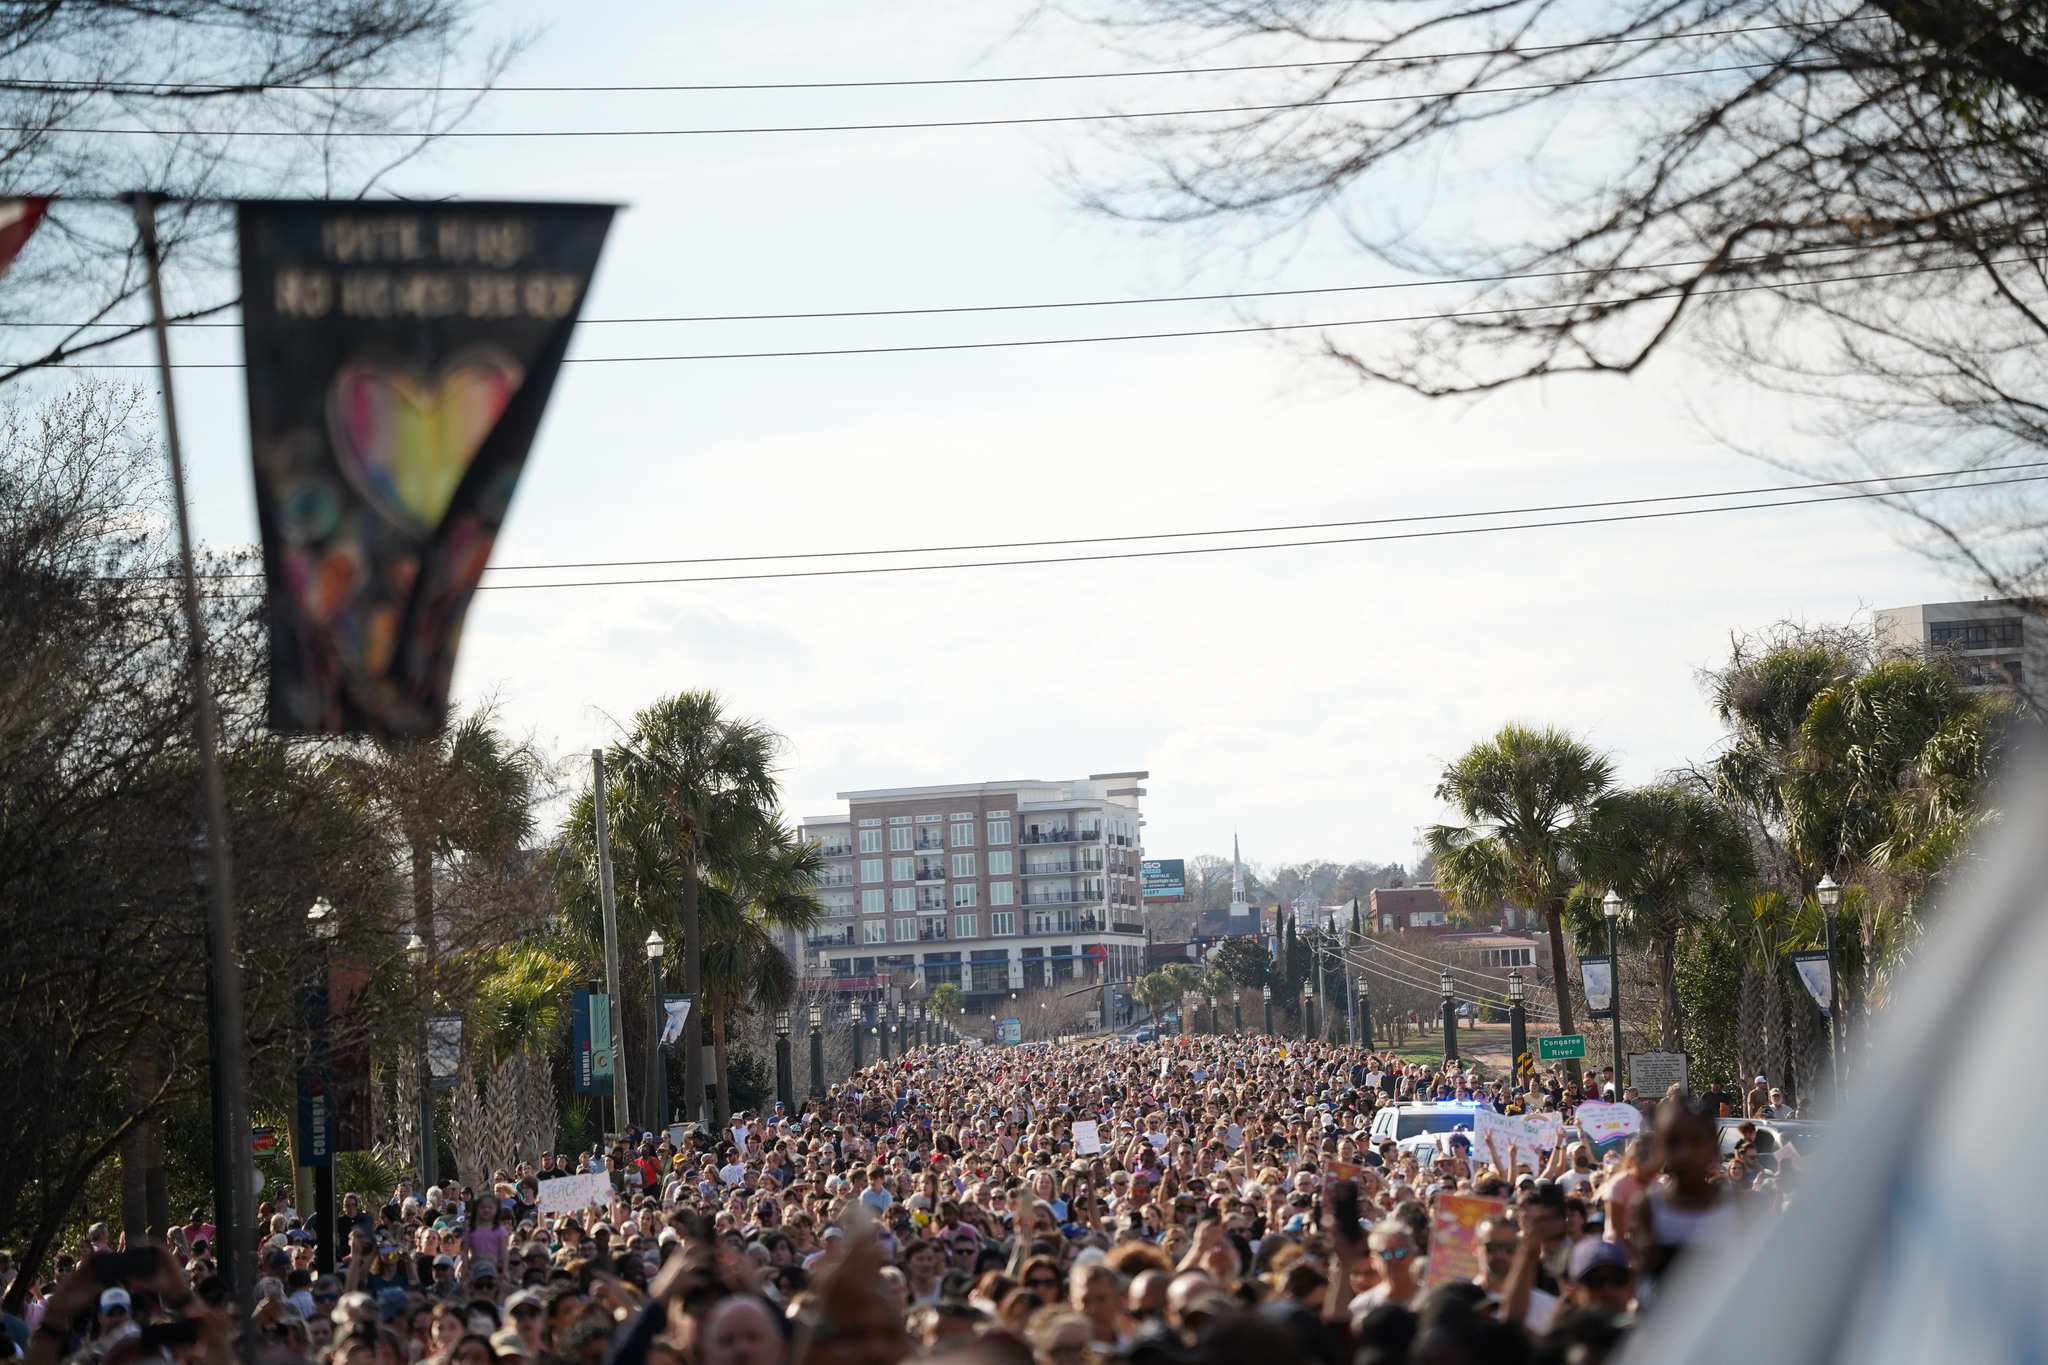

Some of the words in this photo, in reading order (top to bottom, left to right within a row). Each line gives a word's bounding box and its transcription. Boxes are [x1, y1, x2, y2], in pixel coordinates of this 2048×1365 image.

[1543, 1038, 1580, 1046] Congaree
[582, 1050, 590, 1086] COLUMBIA
[312, 1095, 326, 1156] COLUMBIA
